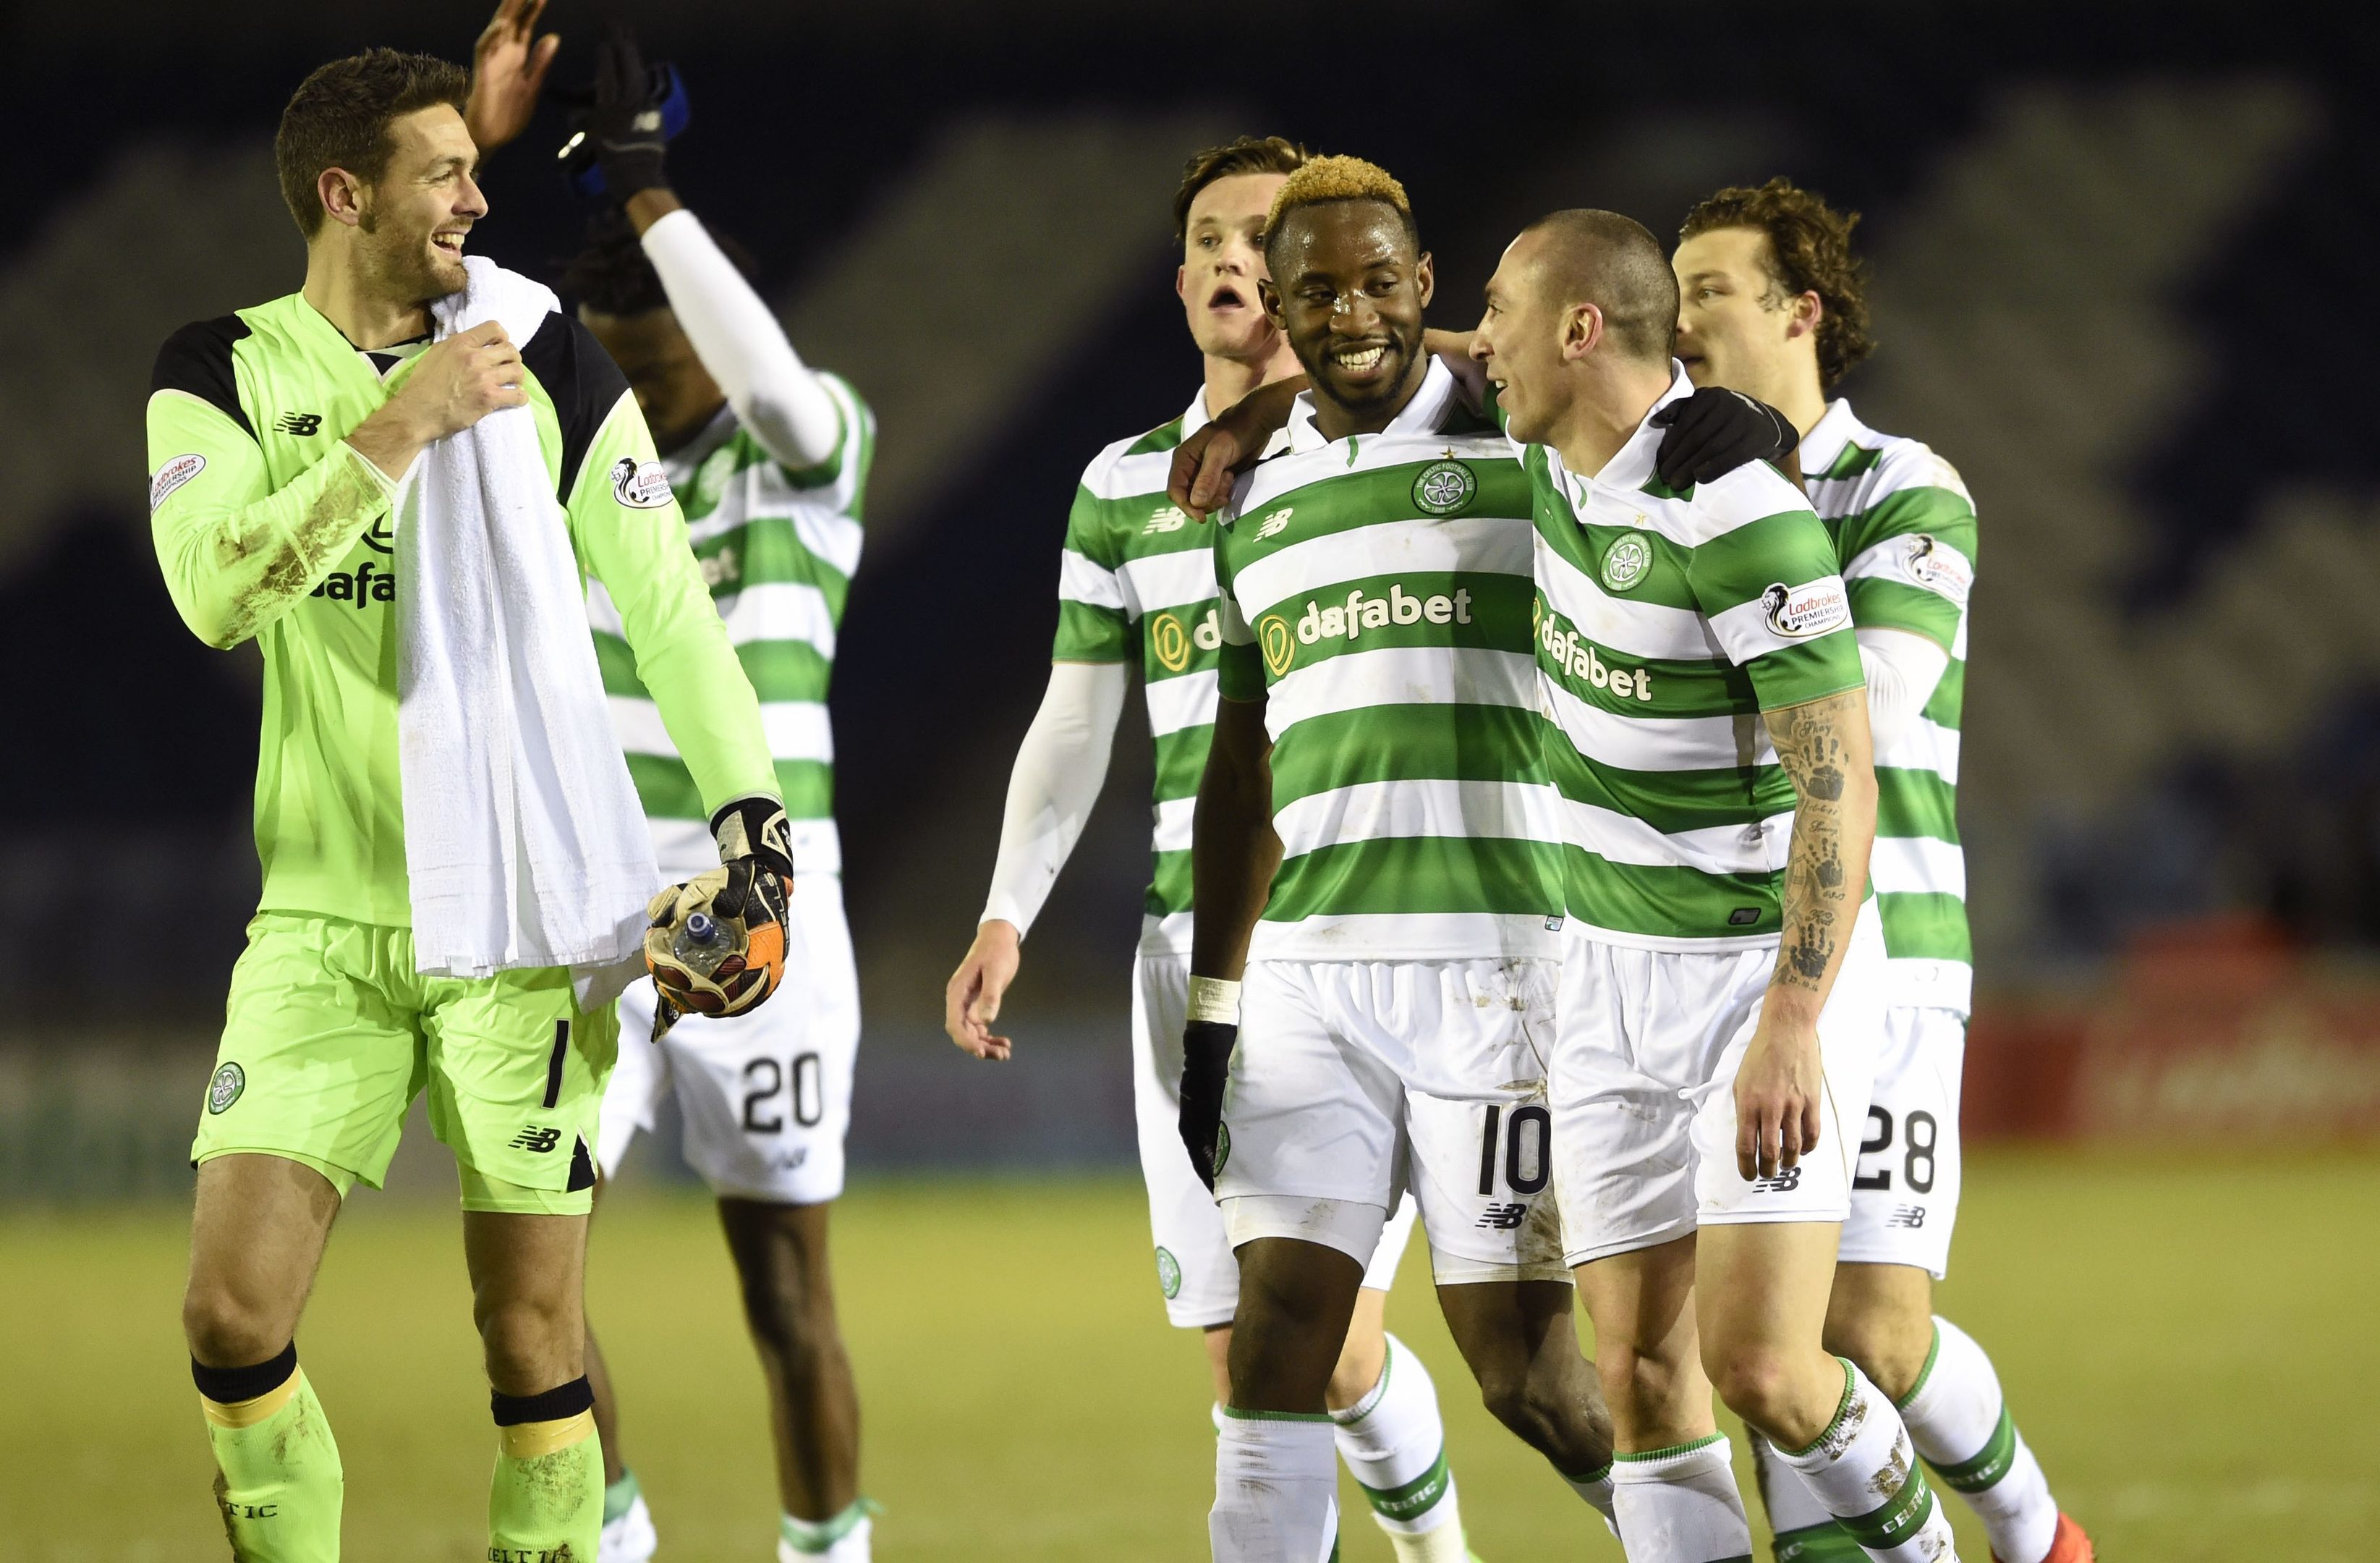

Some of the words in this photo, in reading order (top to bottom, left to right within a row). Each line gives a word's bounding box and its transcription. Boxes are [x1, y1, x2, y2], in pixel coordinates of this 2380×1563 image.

[1423, 464, 1441, 478] CELTIC
[1442, 463, 1469, 478] FOOTBALL
[1296, 583, 1472, 640] dafabet
[1789, 593, 1841, 616] Ladbrokes
[1791, 605, 1843, 624] PREMIERSHIP
[1541, 613, 1652, 701] dafabet
[541, 1019, 571, 1110] 1
[744, 1051, 823, 1134] 20
[1476, 1103, 1552, 1198] 10
[1852, 1104, 1937, 1194] 28
[1882, 1478, 1926, 1535] CELTIC
